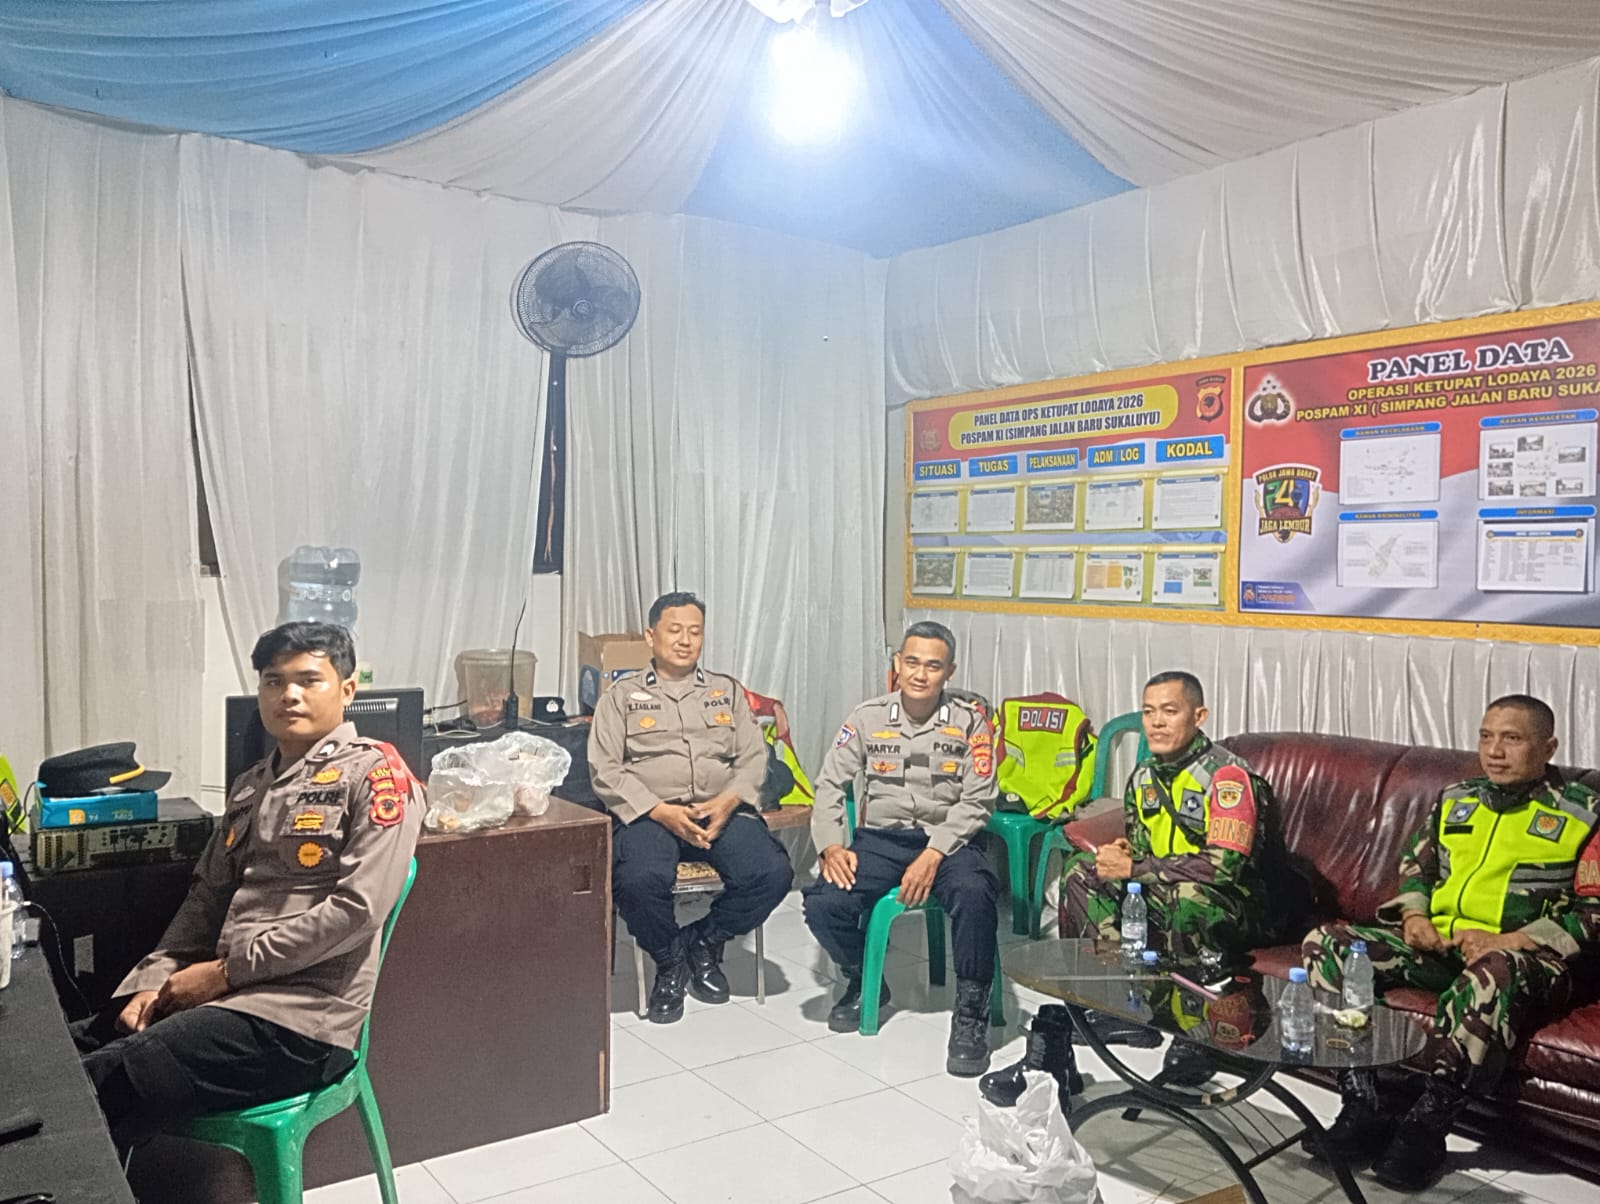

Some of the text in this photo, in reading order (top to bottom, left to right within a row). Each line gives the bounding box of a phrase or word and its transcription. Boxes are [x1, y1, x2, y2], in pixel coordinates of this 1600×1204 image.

[1369, 339, 1572, 382] PANEL DATA
[1348, 364, 1597, 401] OPERASI KETUPAT LODAYA 2026
[973, 394, 1144, 427] PANEL DATA OPS KETUPAT LODAYA 2026
[1296, 405, 1349, 421] POSPAM
[1353, 403, 1367, 416] XI
[1381, 396, 1447, 413] SIMPANG
[1451, 391, 1502, 406] JALAN
[1507, 385, 1552, 401] BARU
[960, 411, 1161, 445] POSPAM XI (SIMPANG JALAN BARU SUKALUYU)
[1093, 451, 1113, 465] ADM
[1120, 448, 1139, 462] LOG
[1166, 441, 1213, 458] KODAL
[919, 463, 957, 477] SITUASI
[978, 460, 1009, 473] TUGAS
[1029, 454, 1076, 469] PELAKSANAAN
[1260, 519, 1278, 533] JAGA
[1020, 709, 1064, 730] POLISI
